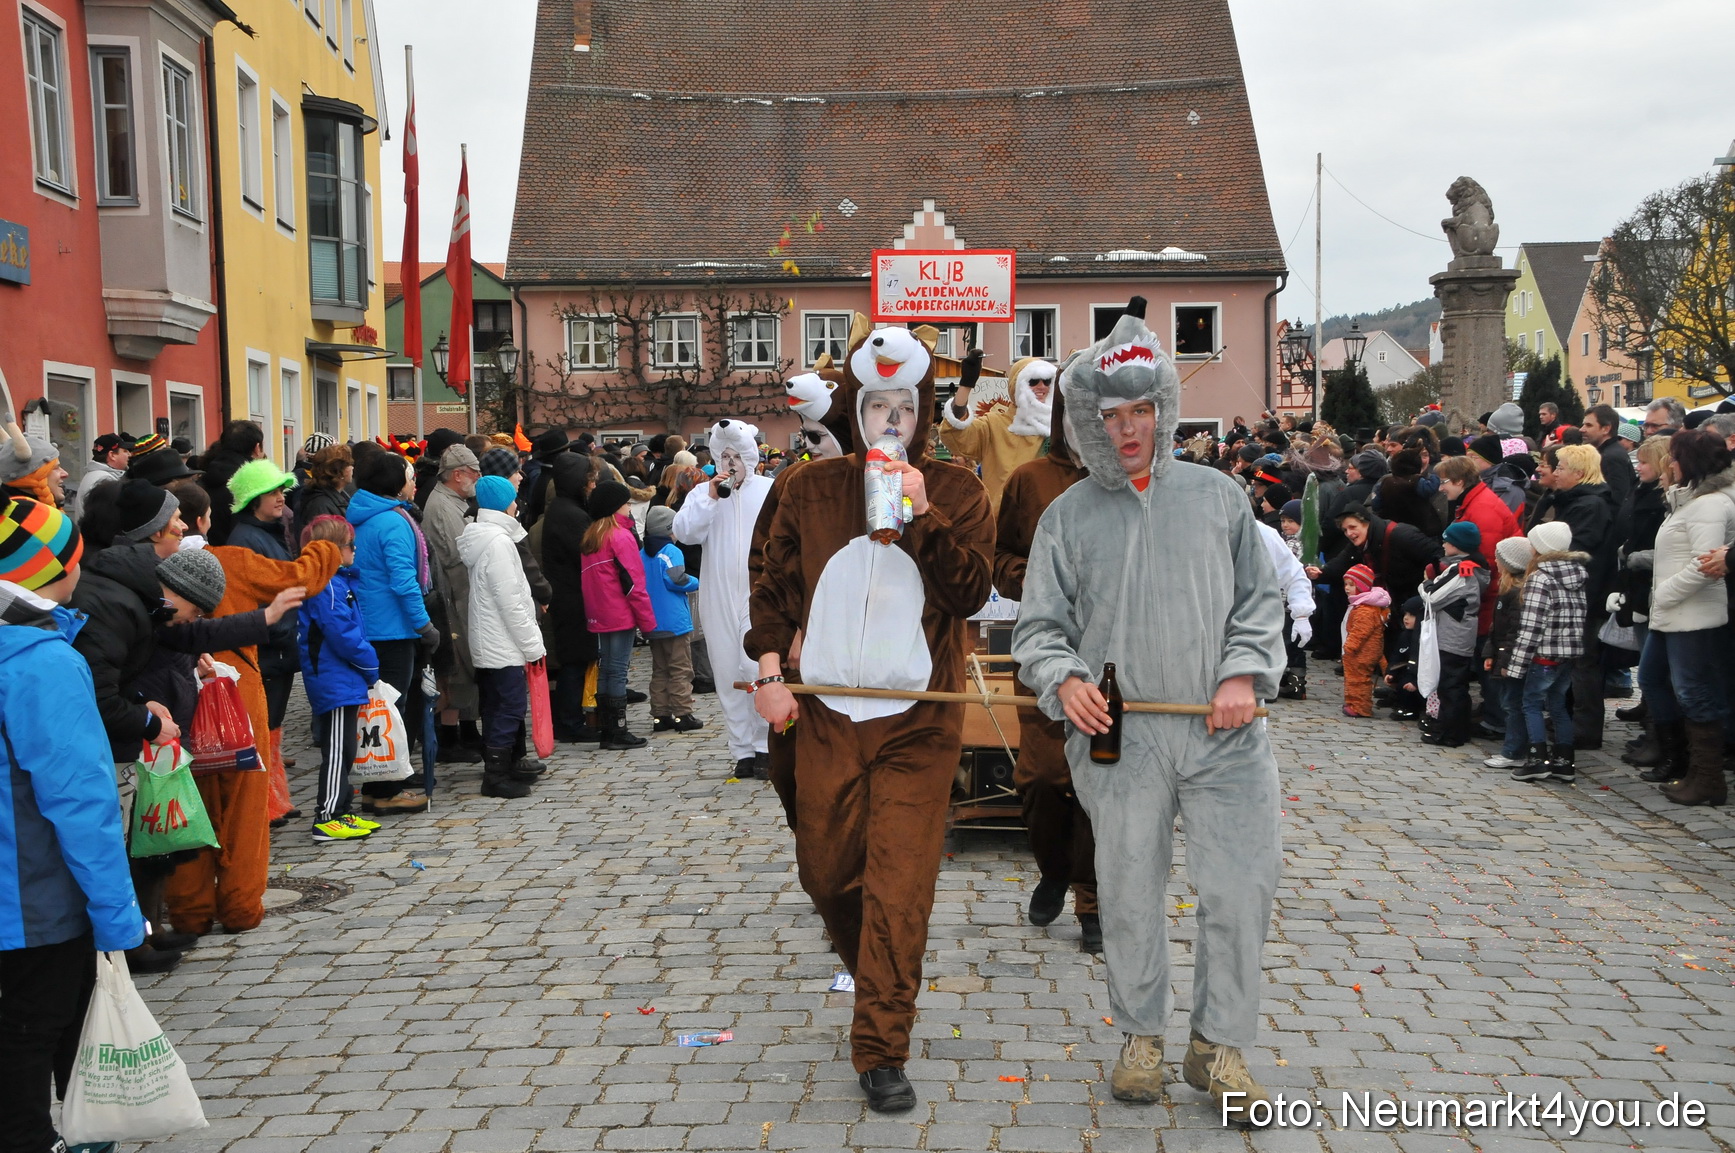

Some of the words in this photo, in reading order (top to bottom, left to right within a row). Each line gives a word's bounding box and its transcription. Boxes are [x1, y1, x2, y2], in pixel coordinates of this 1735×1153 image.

[920, 260, 964, 285] KLJB
[886, 279, 899, 288] 47
[905, 286, 989, 298] WEIDENWANG
[896, 300, 996, 313] GROßBERGHAUSEN
[972, 380, 991, 394] DER
[994, 379, 1008, 389] KÖ
[360, 725, 382, 748] M
[140, 798, 188, 835] H&M
[88, 1071, 100, 1082] Weg
[148, 1067, 161, 1077] sich
[156, 1083, 170, 1092] Wahl
